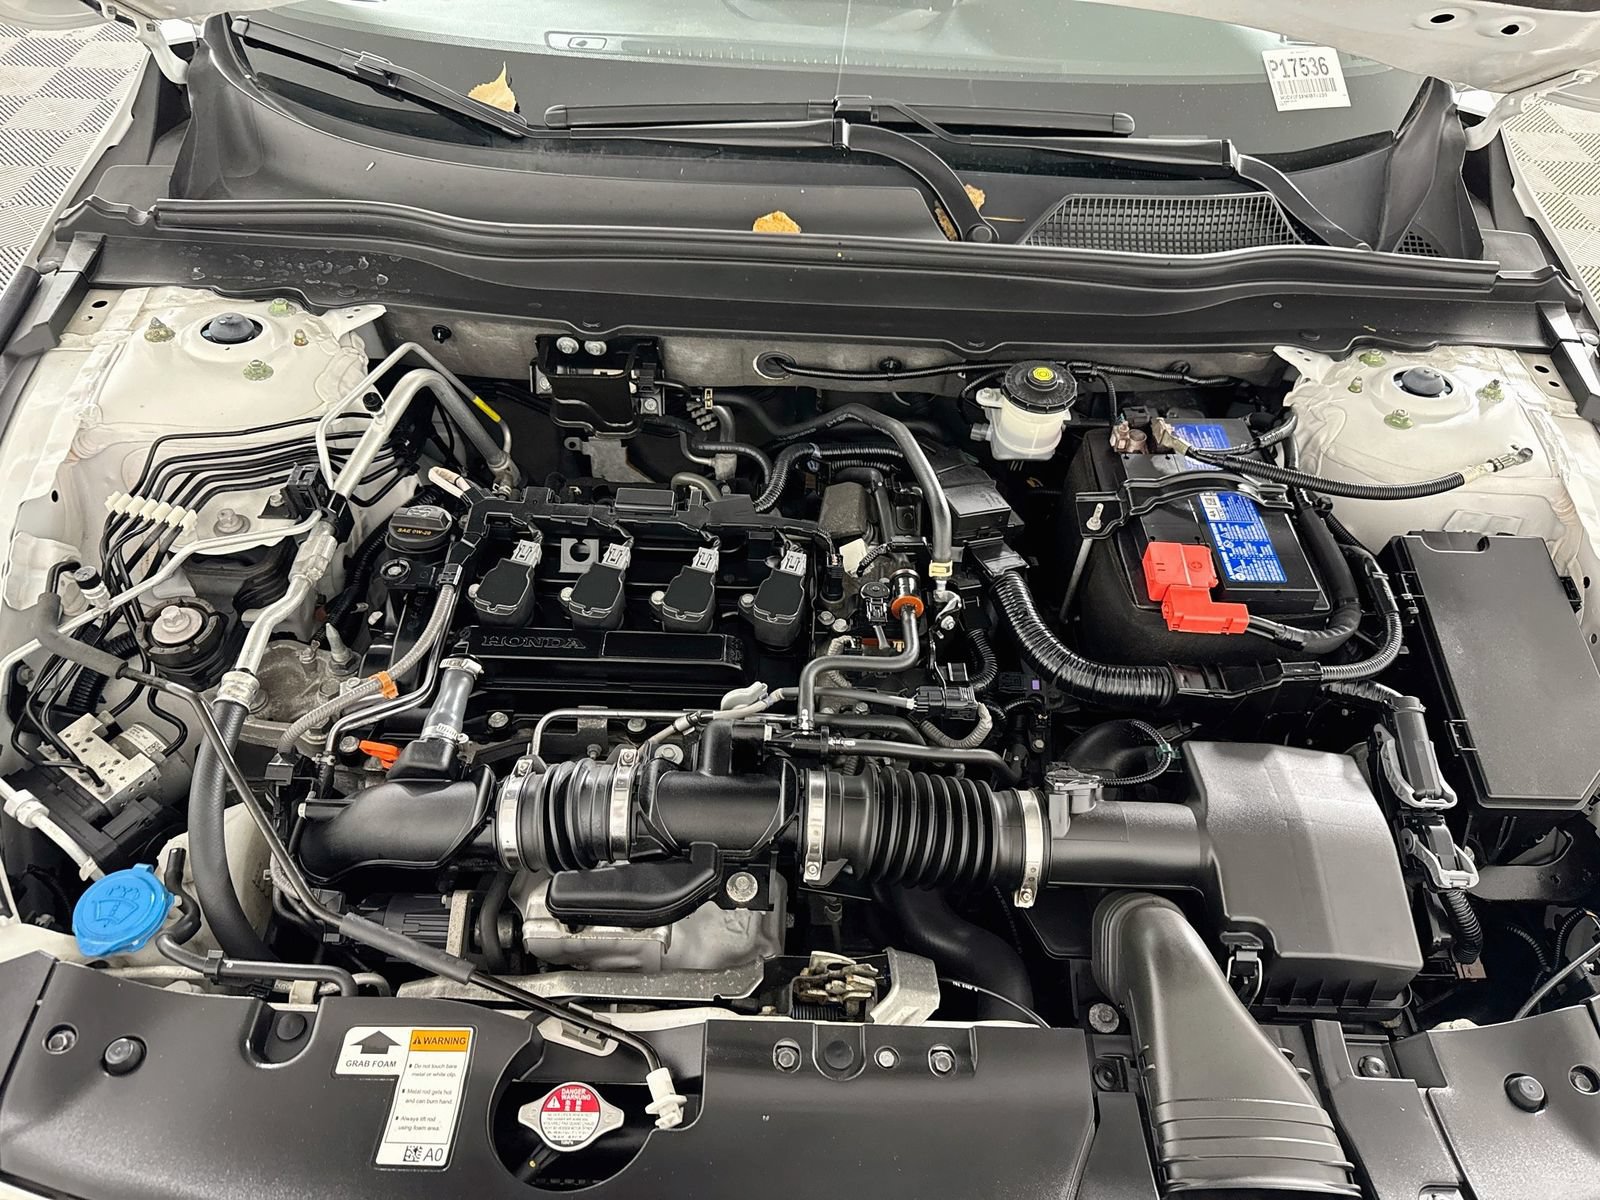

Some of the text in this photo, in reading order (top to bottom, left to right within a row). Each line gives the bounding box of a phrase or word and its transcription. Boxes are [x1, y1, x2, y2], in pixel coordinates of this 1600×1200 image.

[1268, 56, 1329, 79] P17536
[481, 635, 586, 649] HONDA
[423, 1037, 466, 1045] WARNING
[345, 1059, 397, 1068] GRAB FOAM
[423, 1147, 444, 1162] A0
